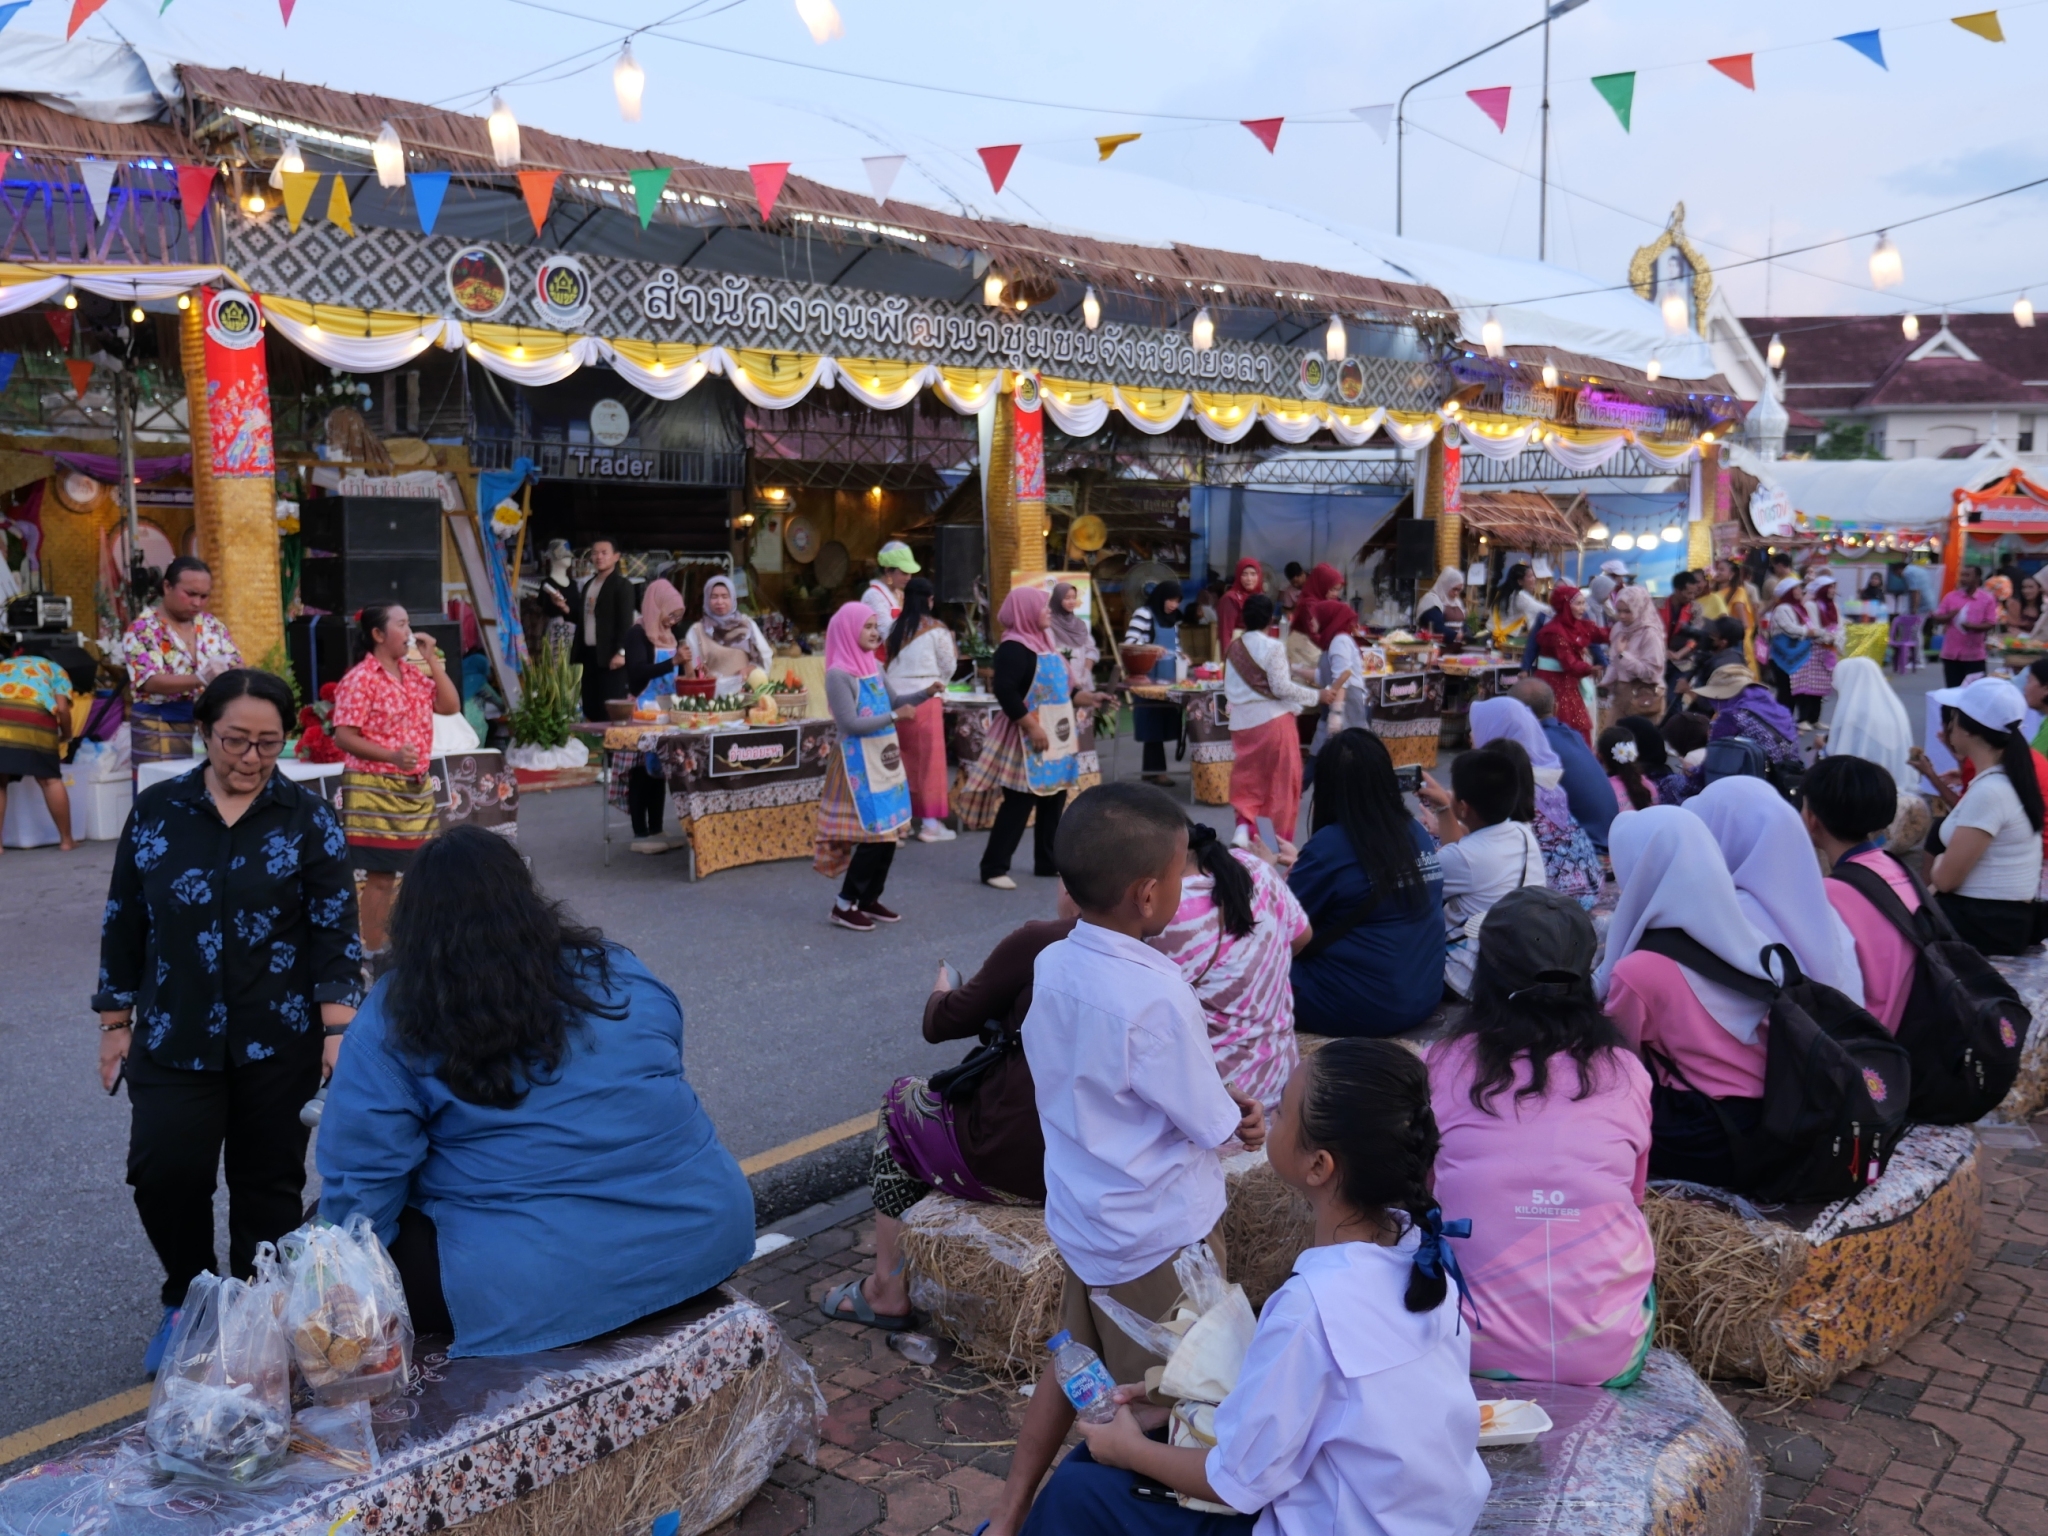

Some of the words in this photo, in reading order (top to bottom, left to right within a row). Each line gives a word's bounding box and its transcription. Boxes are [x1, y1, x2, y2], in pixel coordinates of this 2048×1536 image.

[644, 269, 1272, 383] สำนักงานพัฒนาชุมชนจังหวัดยะลา
[575, 451, 653, 477] Trader
[1532, 1189, 1565, 1205] 5.0
[1515, 1206, 1580, 1216] KILOMETERS
